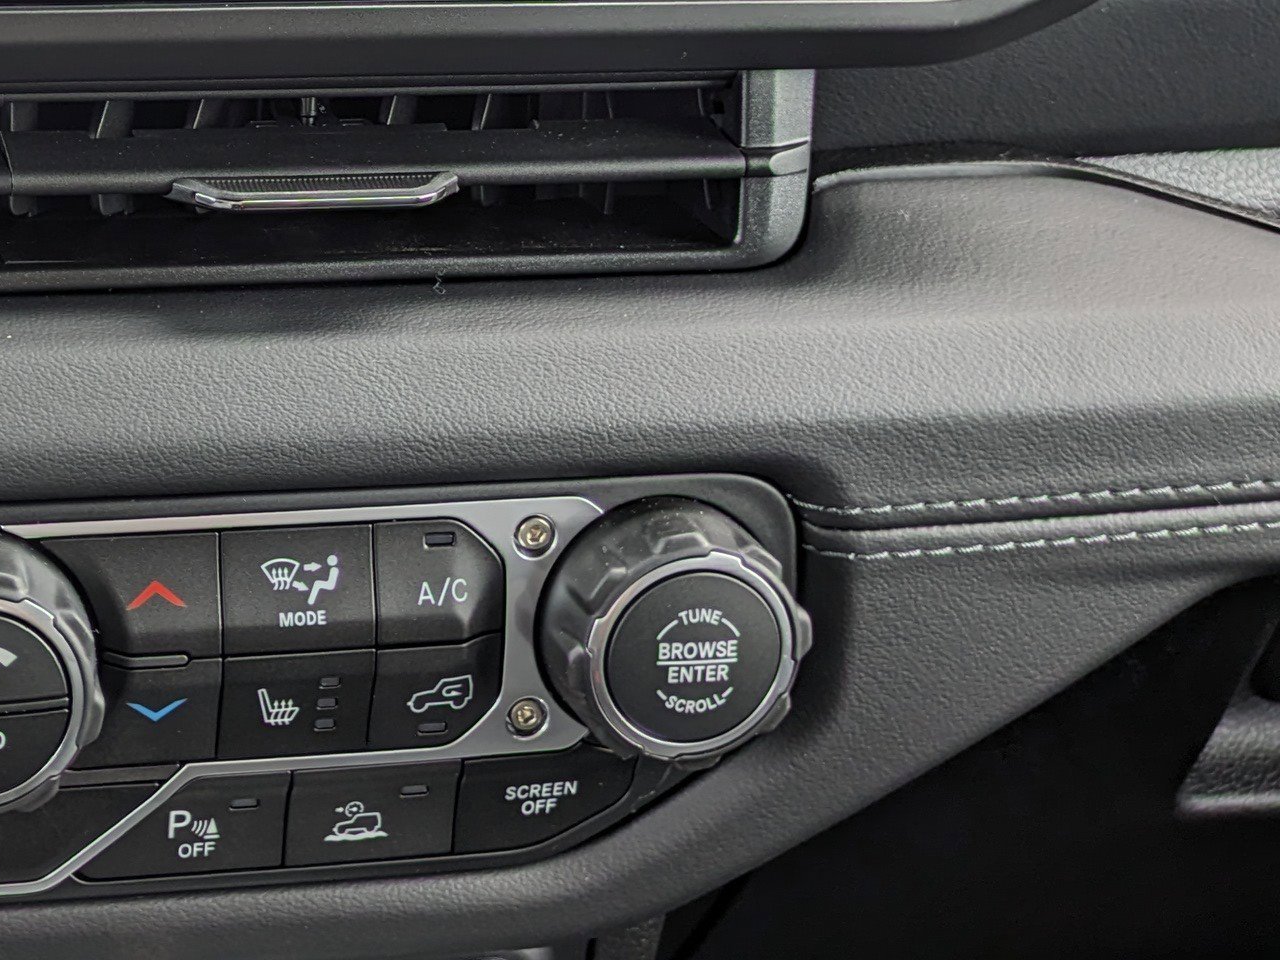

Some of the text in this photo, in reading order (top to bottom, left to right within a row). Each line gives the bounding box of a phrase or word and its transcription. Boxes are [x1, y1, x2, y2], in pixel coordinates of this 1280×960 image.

[418, 578, 468, 607] A/C
[278, 610, 327, 628] MODE
[678, 608, 723, 626] TUNE
[658, 639, 739, 661] BROWSE
[668, 665, 730, 684] ENTER
[664, 693, 726, 715] SCROLL
[505, 780, 578, 801] SCREEN
[521, 798, 557, 816] OFF
[178, 842, 217, 859] OFF
